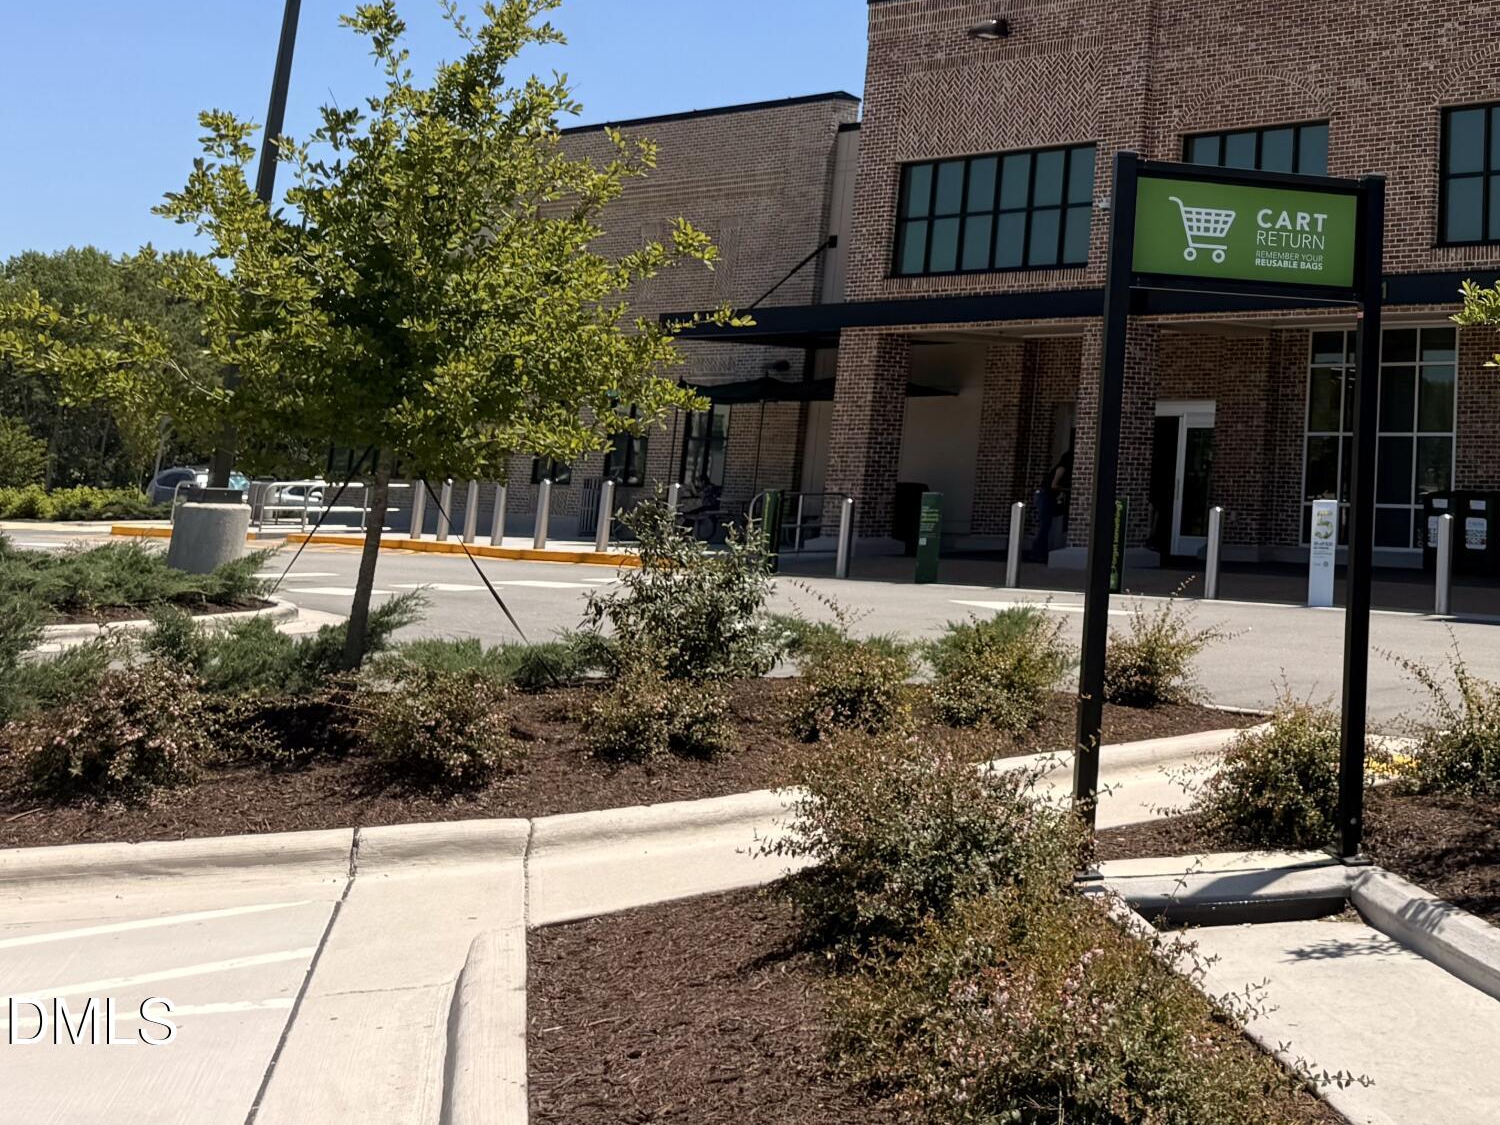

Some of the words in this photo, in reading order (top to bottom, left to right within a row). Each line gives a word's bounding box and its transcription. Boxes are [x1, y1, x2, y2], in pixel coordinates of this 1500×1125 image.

[1256, 208, 1328, 232] CART
[1256, 230, 1325, 250] RETURN
[1255, 250, 1300, 261] REMEMBER
[1301, 253, 1324, 263] YOUR
[1255, 258, 1299, 269] REUSABLE
[1300, 261, 1324, 271] BAGS
